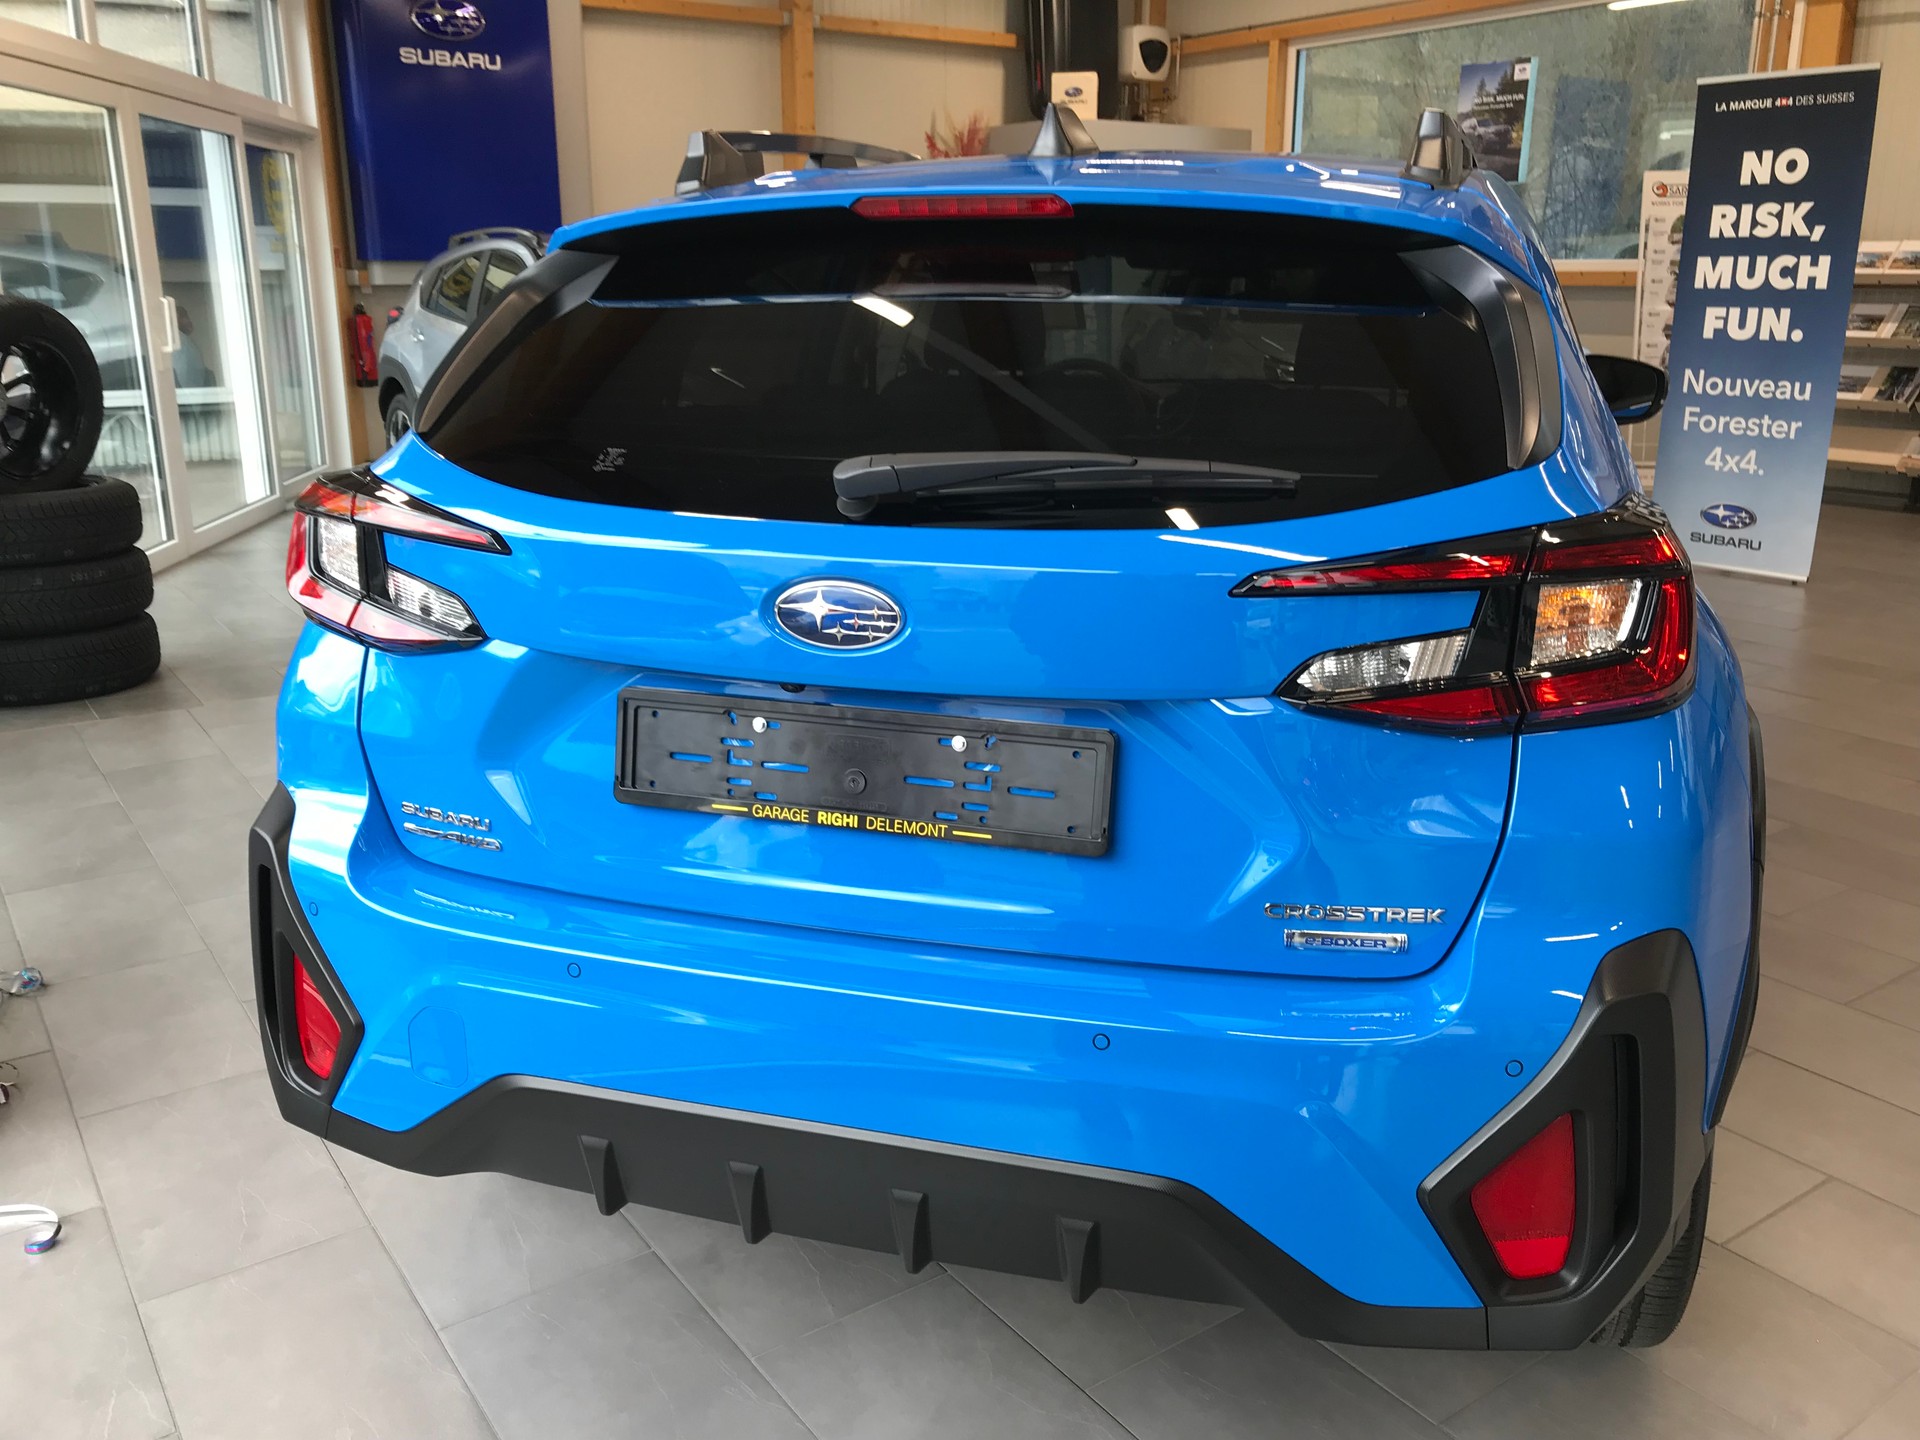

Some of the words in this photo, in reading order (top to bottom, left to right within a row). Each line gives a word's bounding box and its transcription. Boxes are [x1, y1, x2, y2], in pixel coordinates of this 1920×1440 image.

[399, 47, 501, 70] SUBARU
[1715, 101, 1727, 112] LA
[1729, 97, 1773, 111] MARQUE
[1795, 94, 1814, 107] DES
[1816, 91, 1855, 104] SUISSES
[1740, 147, 1809, 186] NO
[1709, 201, 1826, 242] RISK,
[1694, 255, 1831, 290] MUCH
[1703, 306, 1804, 342] FUN.
[1682, 368, 1812, 401] Nouveau
[1682, 405, 1802, 440] Forester
[1704, 446, 1765, 477] 4x4.
[1689, 531, 1762, 551] SUBARU
[401, 801, 491, 831] SUBARU
[752, 804, 810, 823] GARAGE
[817, 811, 859, 828] RIGHI
[866, 816, 949, 838] DELEMONT
[1264, 902, 1447, 924] CROSSTREK
[1304, 936, 1387, 949] e-BOXER
